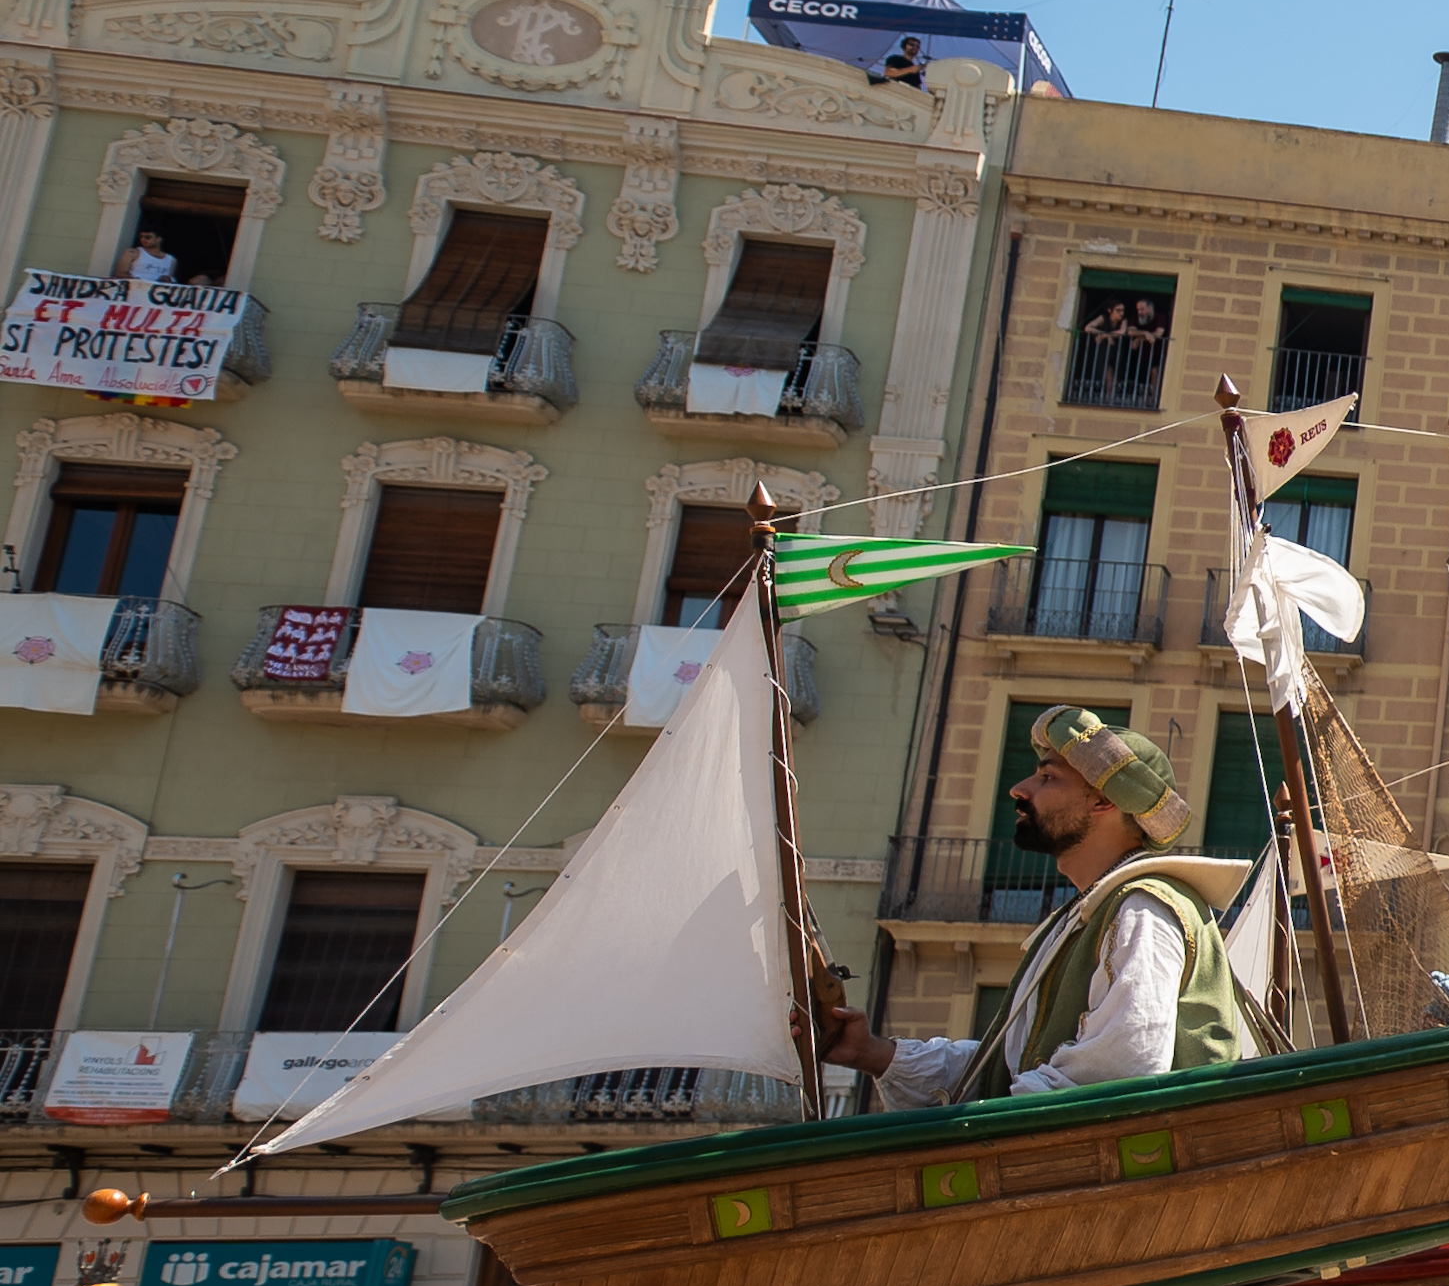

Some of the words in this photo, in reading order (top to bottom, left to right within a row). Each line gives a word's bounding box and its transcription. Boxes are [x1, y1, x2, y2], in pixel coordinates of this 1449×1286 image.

[30, 273, 130, 302] SANDRA
[148, 284, 242, 314] GUAITA
[33, 299, 85, 323] ET
[99, 305, 207, 336] MULTA
[53, 326, 218, 369] PROTESTES!
[1299, 419, 1327, 445] REUS
[78, 1066, 160, 1076] REHABILITACIONS
[218, 1254, 367, 1286] cajamar
